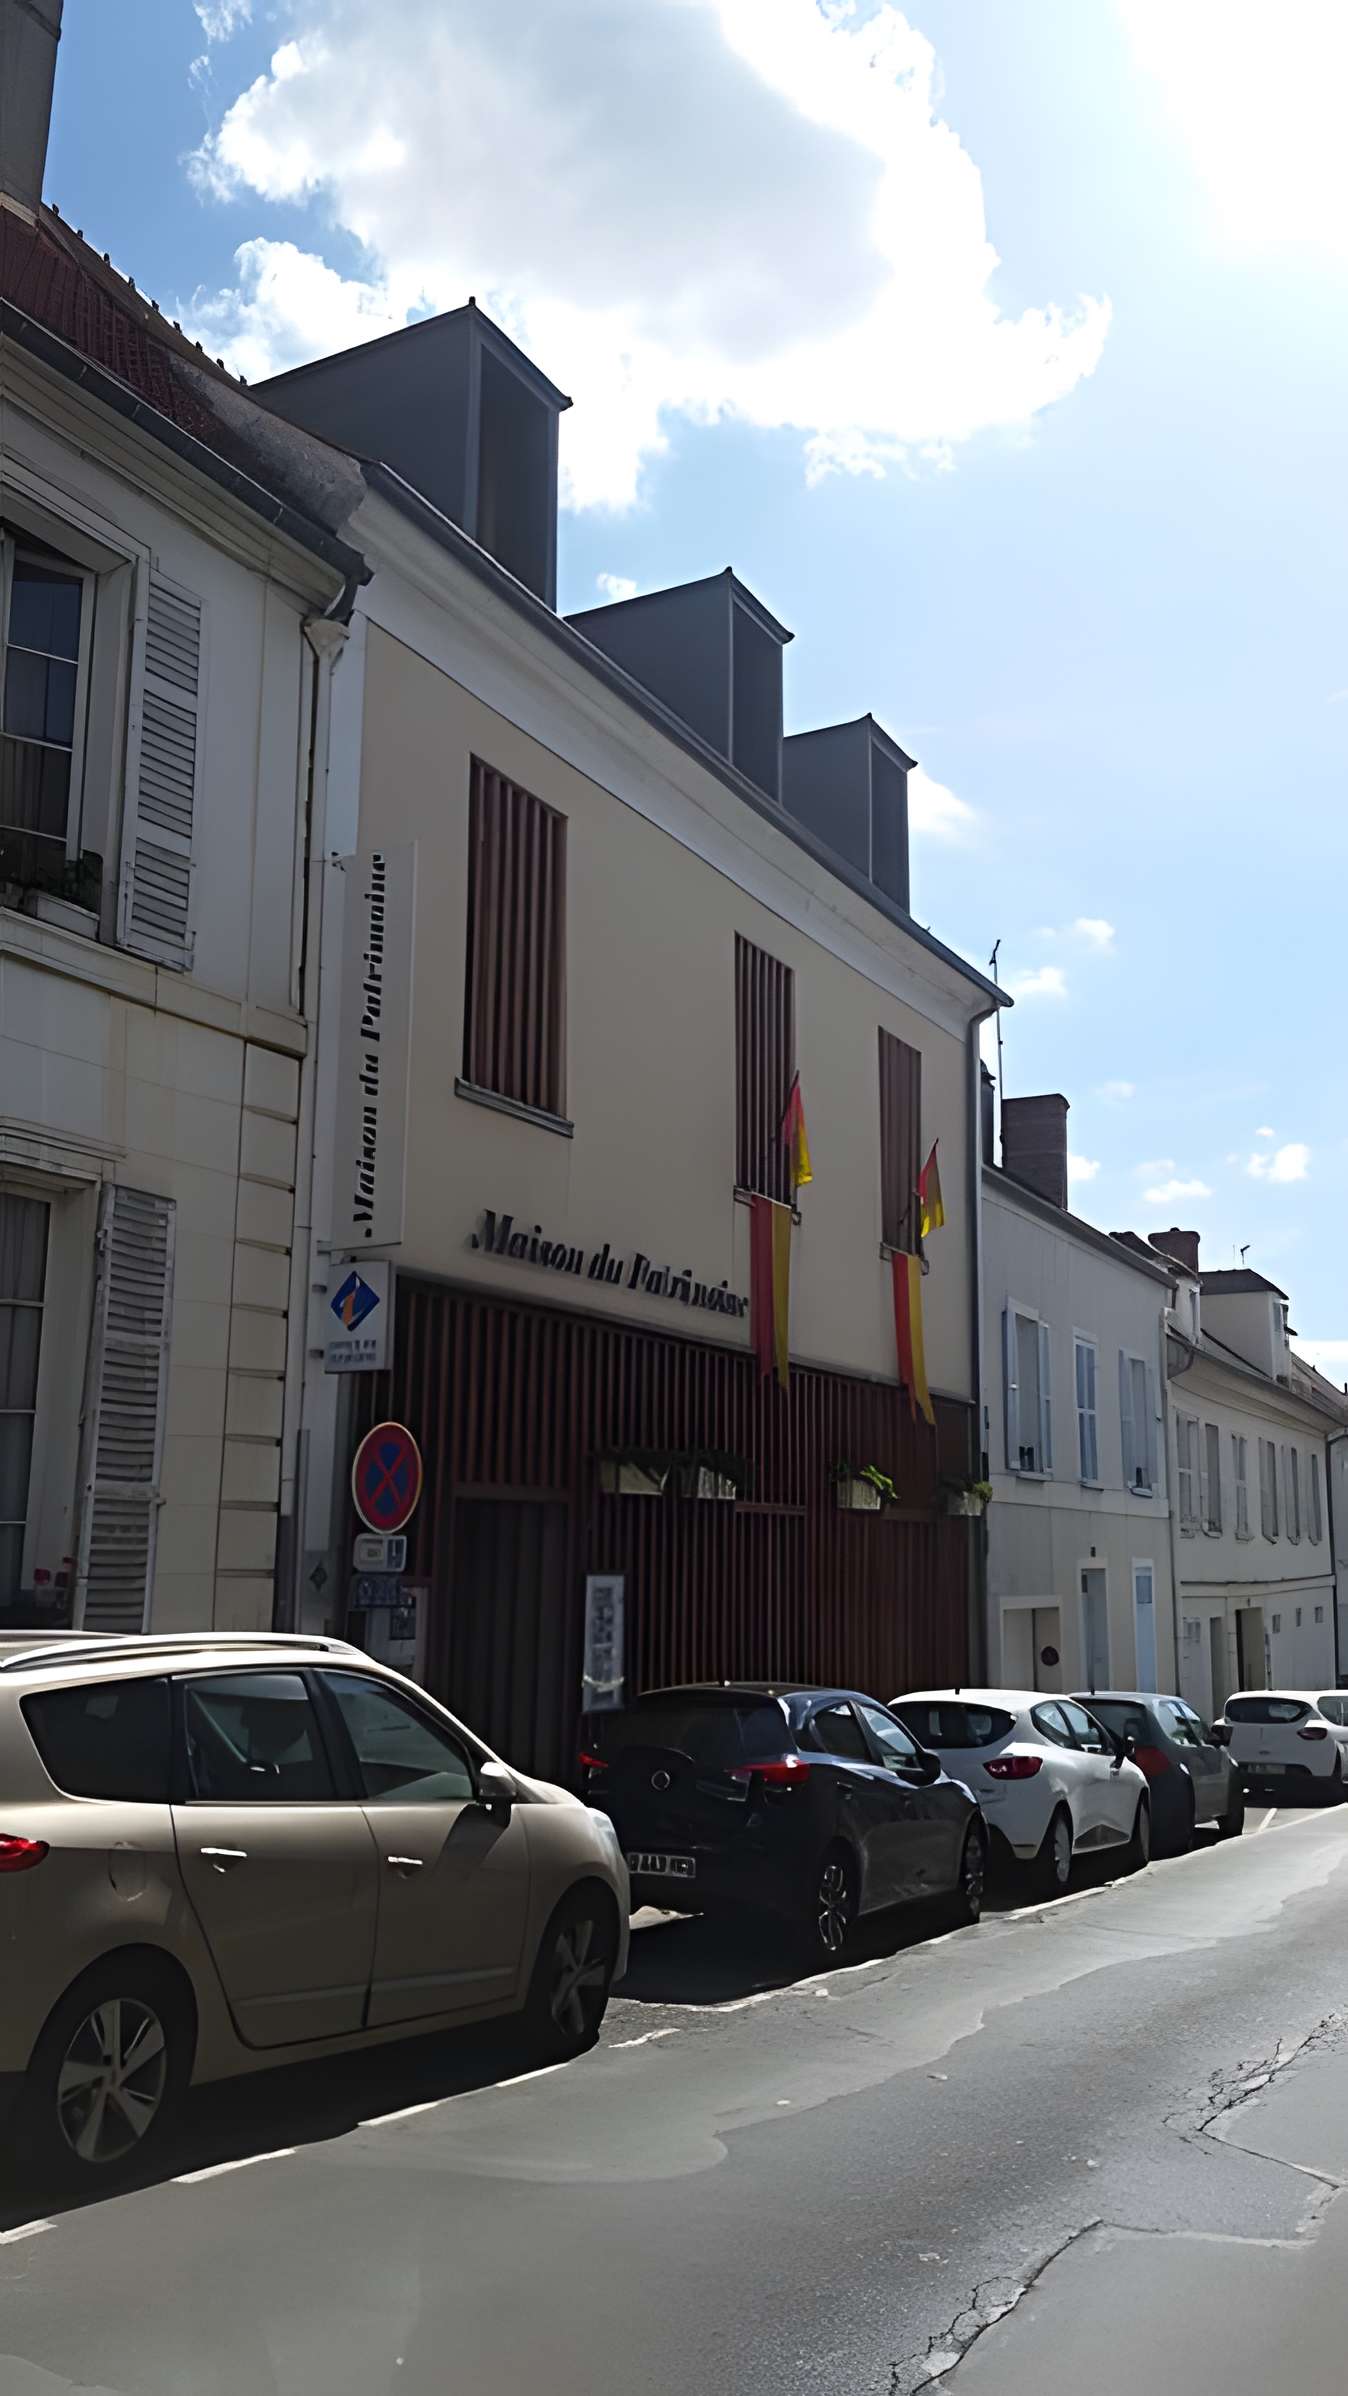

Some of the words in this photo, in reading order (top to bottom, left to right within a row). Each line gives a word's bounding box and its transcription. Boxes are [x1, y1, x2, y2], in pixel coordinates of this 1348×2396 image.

[361, 853, 386, 1042] Patrimoine
[359, 1053, 380, 1097] du
[353, 1106, 378, 1238] Maison
[470, 1207, 584, 1275] Maison
[587, 1243, 624, 1284] du
